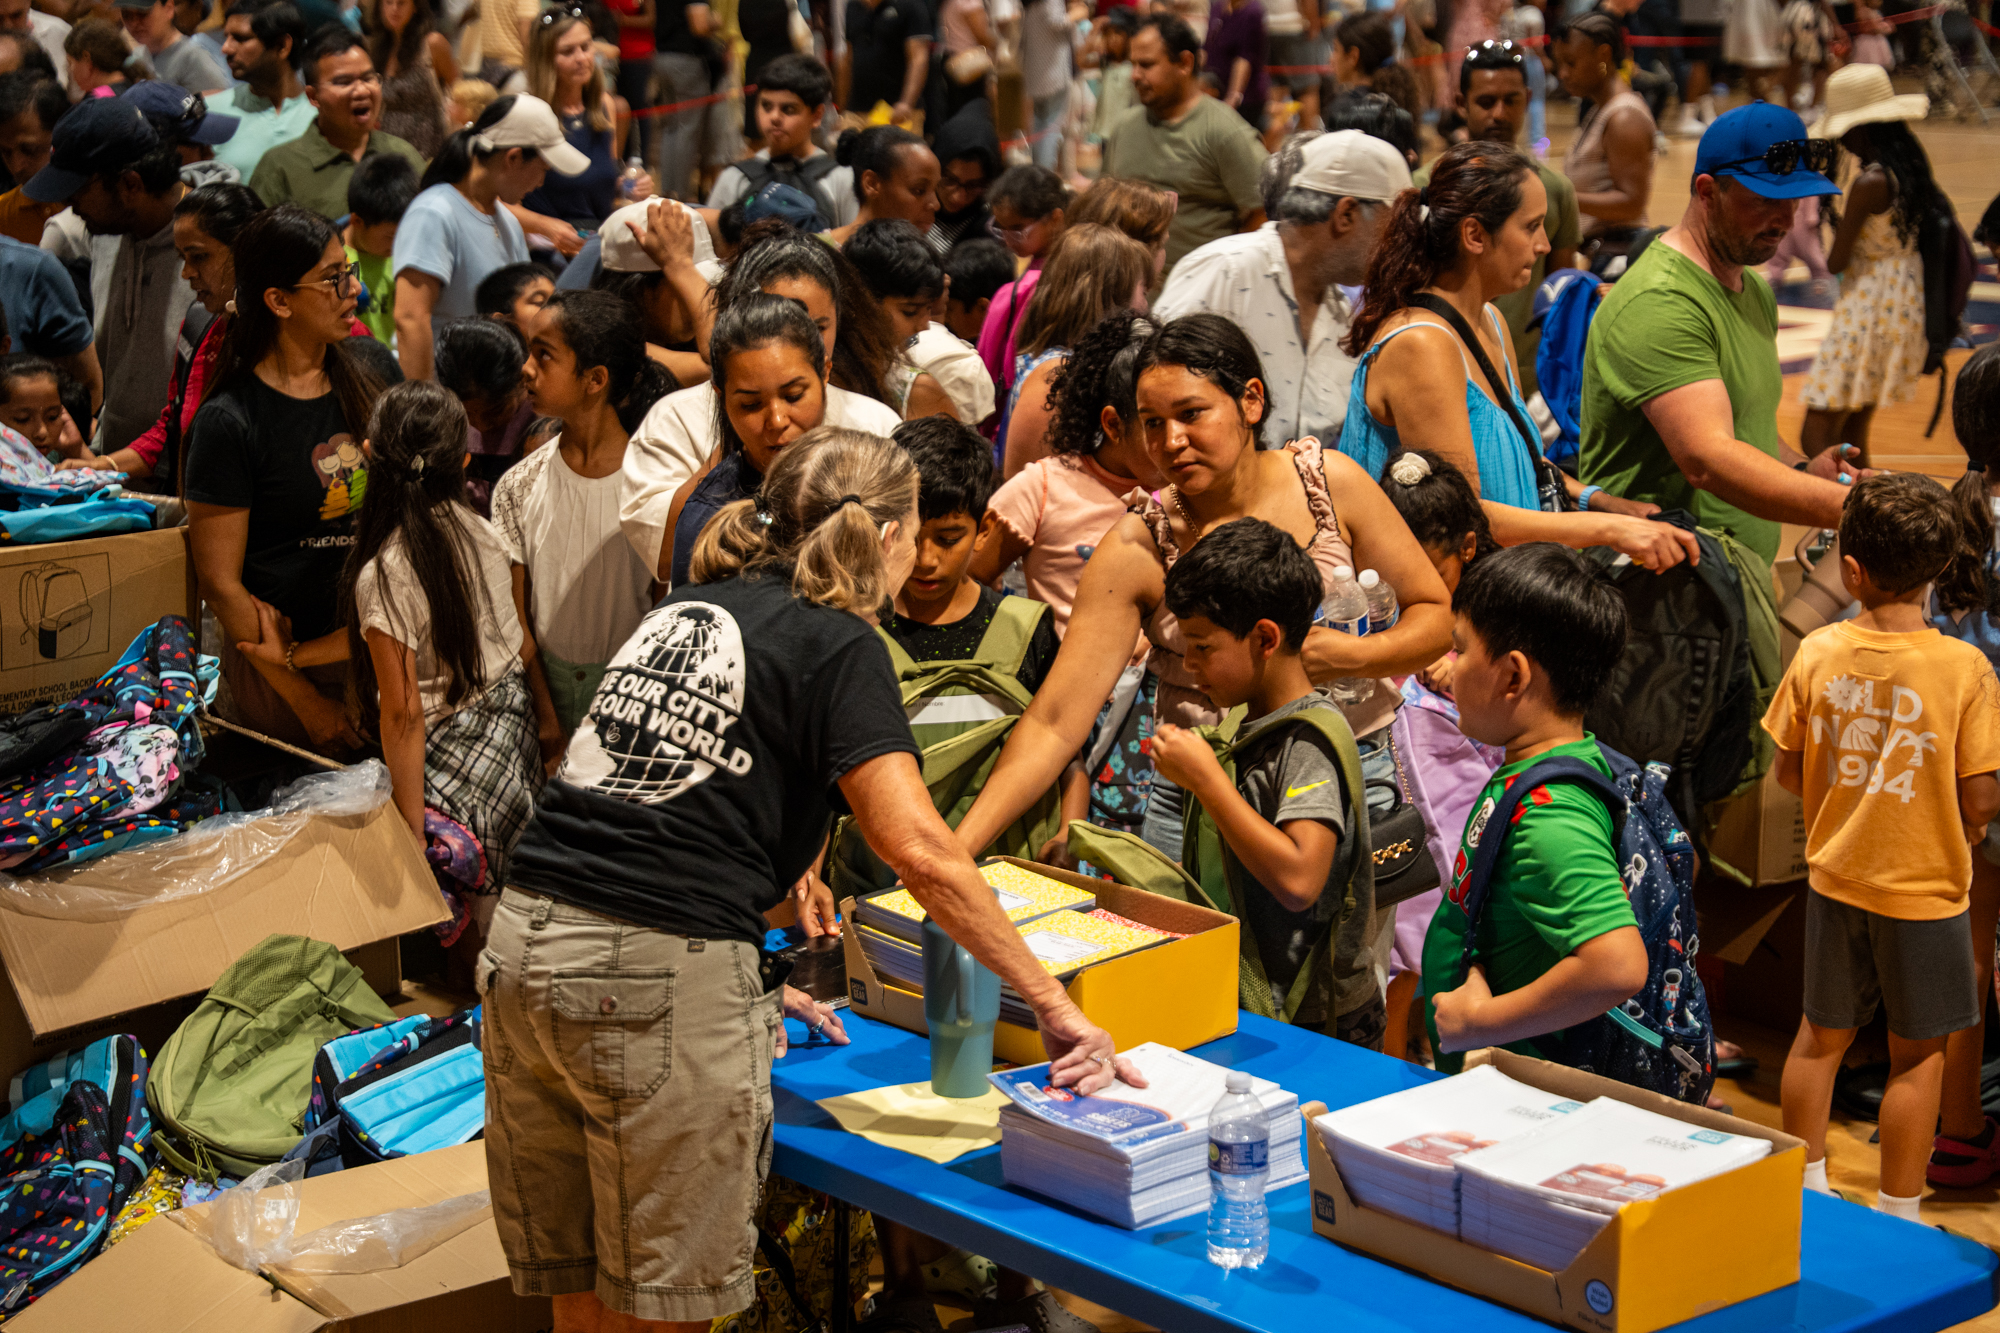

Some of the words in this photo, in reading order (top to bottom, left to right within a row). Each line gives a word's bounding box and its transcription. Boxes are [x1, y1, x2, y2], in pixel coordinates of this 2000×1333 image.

[39, 682, 68, 695] SCHOOL
[618, 673, 668, 707] OUR
[669, 690, 739, 736] CITY
[600, 693, 647, 727] OUR
[646, 707, 753, 777] WORLD
[1827, 750, 1917, 804] 1994
[33, 1034, 66, 1048] HECHO
[69, 1029, 82, 1038] EN
